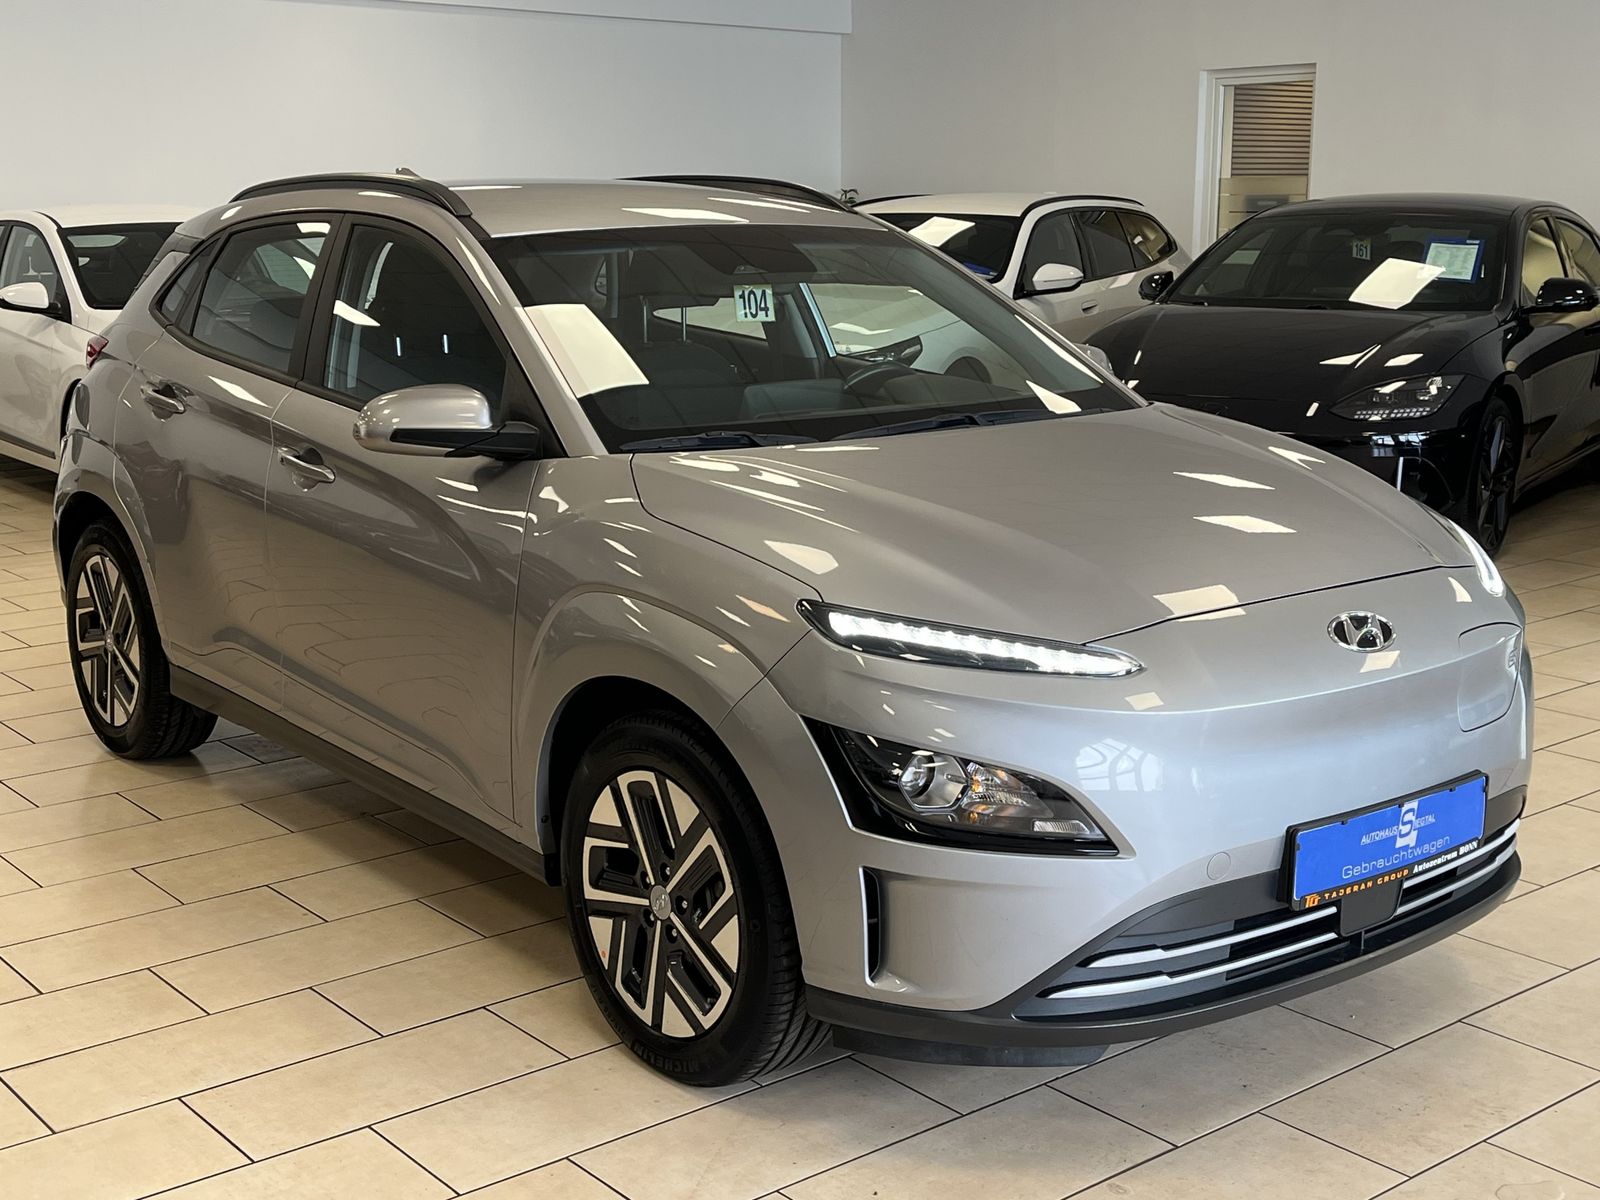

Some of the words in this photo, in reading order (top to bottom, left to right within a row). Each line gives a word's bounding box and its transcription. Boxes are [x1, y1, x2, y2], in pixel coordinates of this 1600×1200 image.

[1355, 242, 1368, 259] 161
[738, 289, 770, 319] 104
[1360, 825, 1399, 846] AUTOHAUS
[1341, 836, 1450, 879] Gebrauchtwagen
[1377, 868, 1409, 885] GROUP
[1412, 851, 1458, 874] Autozentrum
[633, 1042, 700, 1073] MICHELIN
